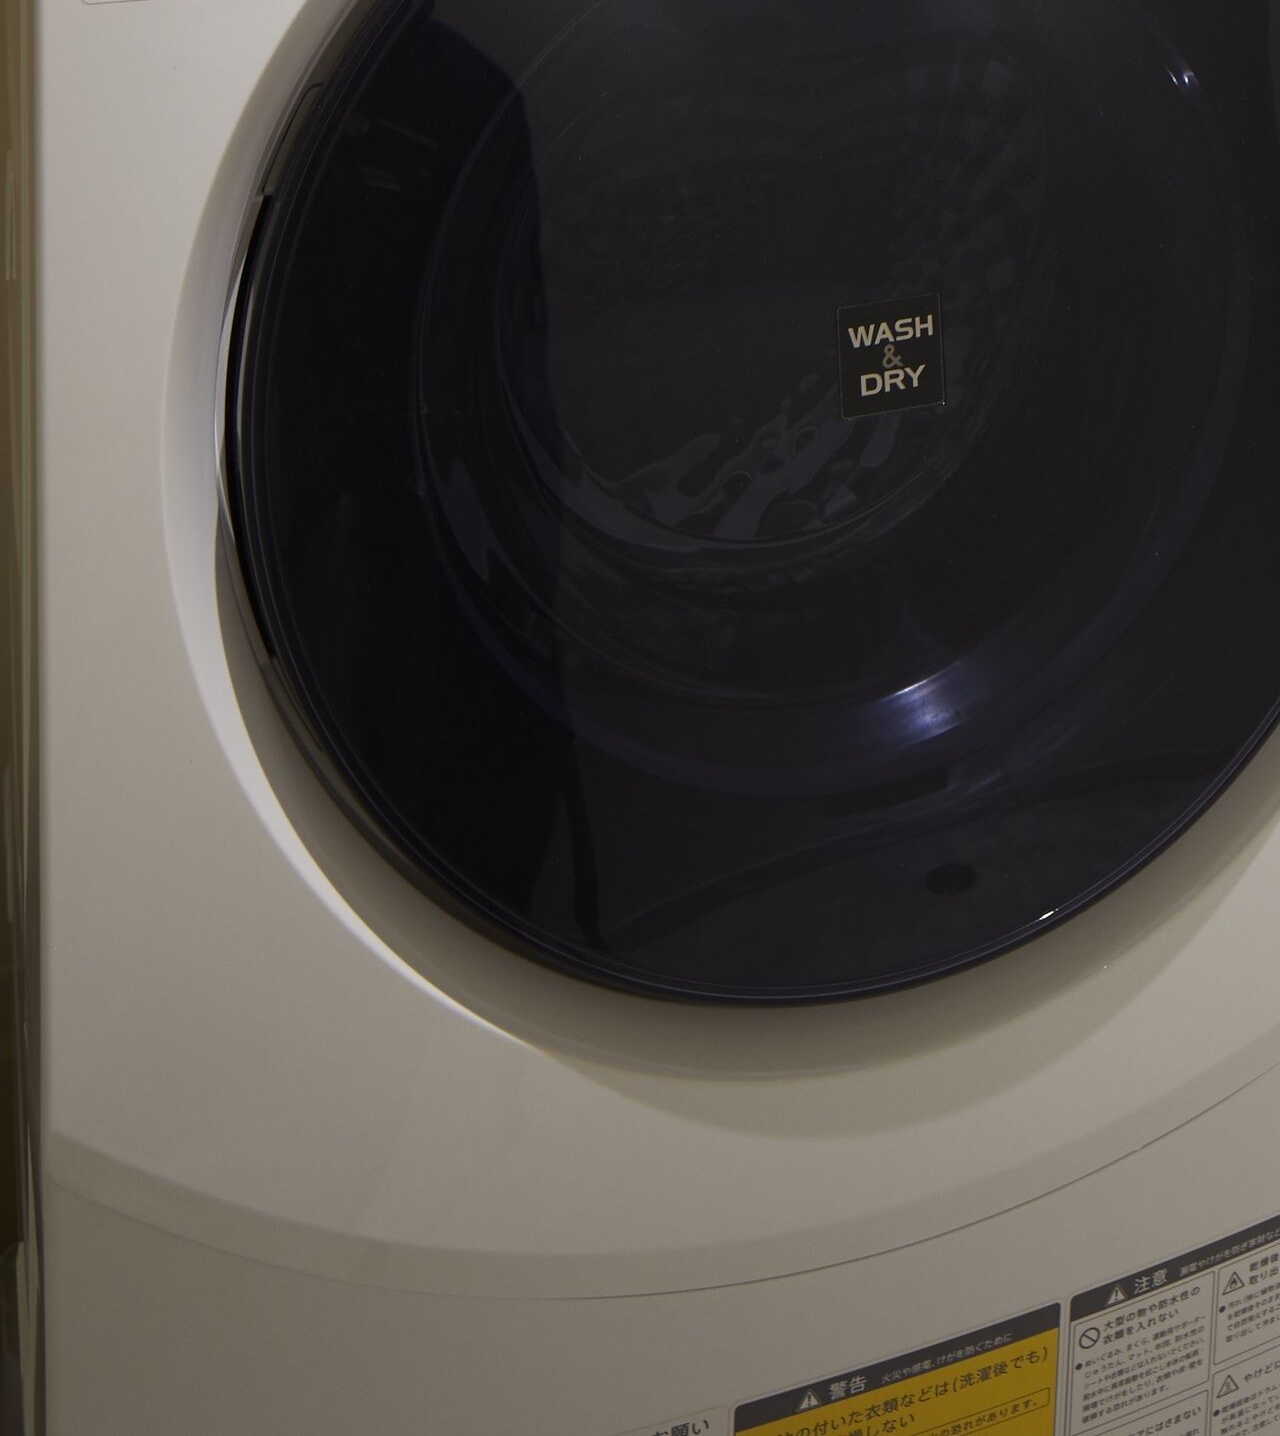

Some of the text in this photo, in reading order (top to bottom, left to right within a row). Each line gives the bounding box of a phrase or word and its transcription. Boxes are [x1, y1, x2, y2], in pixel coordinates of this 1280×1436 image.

[848, 315, 933, 348] WASH
[882, 344, 903, 368] &
[860, 365, 926, 396] DRY
[1134, 1268, 1168, 1295] 注意
[830, 1376, 867, 1401] 警告
